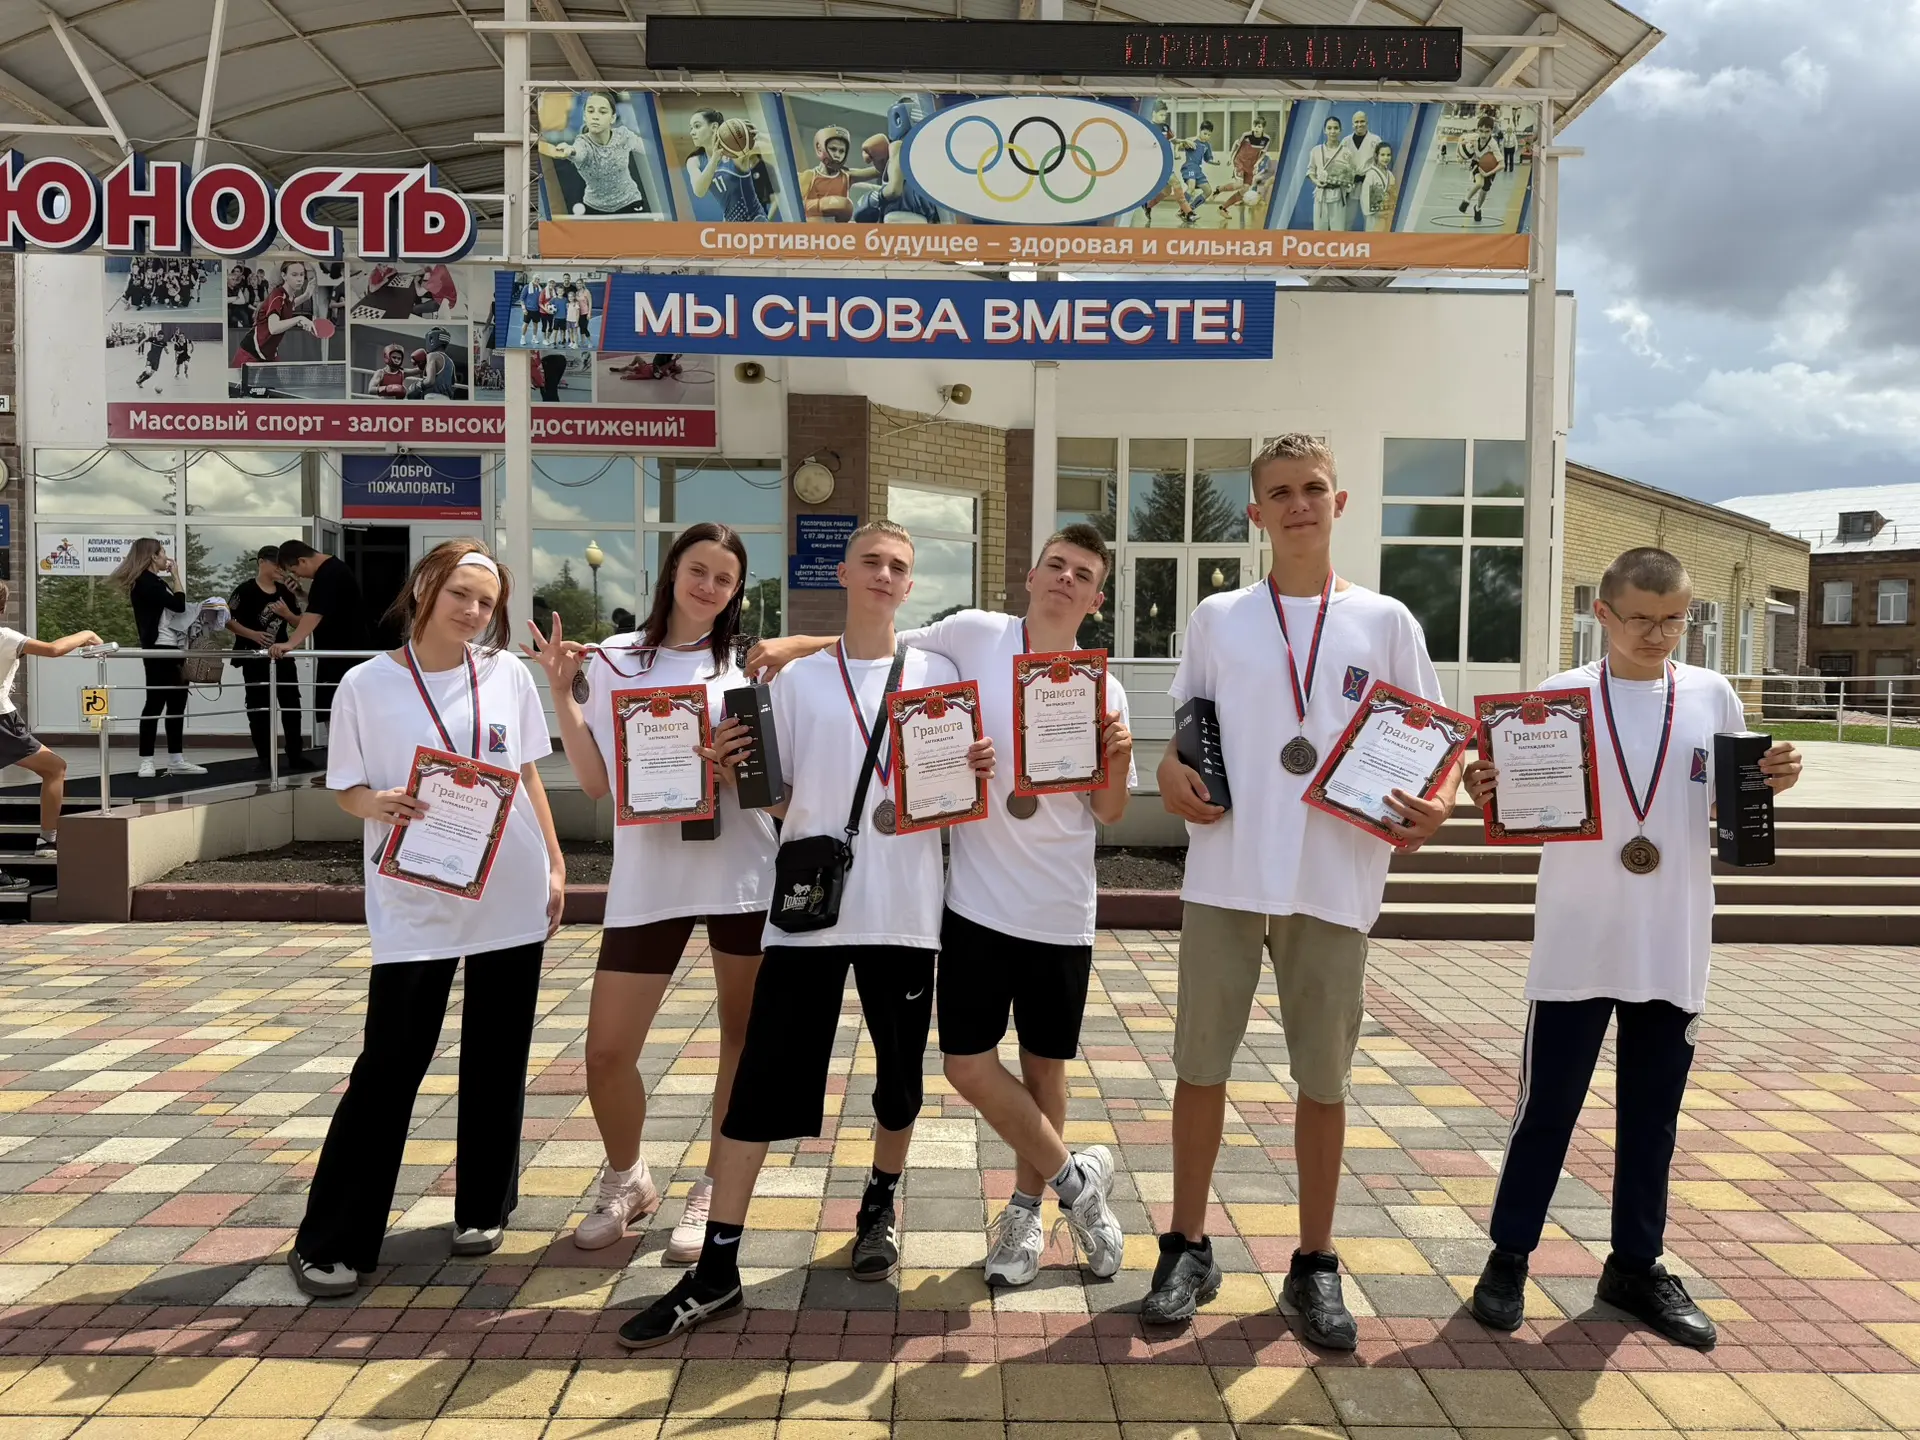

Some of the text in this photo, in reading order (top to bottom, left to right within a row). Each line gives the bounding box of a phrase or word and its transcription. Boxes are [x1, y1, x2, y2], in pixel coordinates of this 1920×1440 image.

[0, 149, 474, 260] ЮНОСТЬ
[699, 227, 856, 255] Спортивное
[864, 228, 978, 257] будущее
[1009, 235, 1133, 258] здоровая
[1142, 238, 1157, 255] и
[1166, 238, 1272, 257] сильная
[1282, 235, 1371, 258] Россия
[633, 290, 1245, 344] МЫ СНОВА ВМЕСТЕ!
[129, 410, 248, 431] Массовый
[256, 414, 324, 435] спорт
[348, 415, 414, 433] залог
[421, 416, 506, 434] высоки
[530, 416, 686, 438] достижений!
[390, 464, 432, 478] ДОБРО
[367, 481, 455, 494] ПОЖАЛОВАТЬ!
[1034, 688, 1086, 703] Грамота
[636, 721, 689, 736] Грамота
[912, 721, 963, 739] Грамота
[1375, 719, 1435, 752] Грамота
[1504, 729, 1568, 745] Грамота
[431, 781, 489, 809] Грамота
